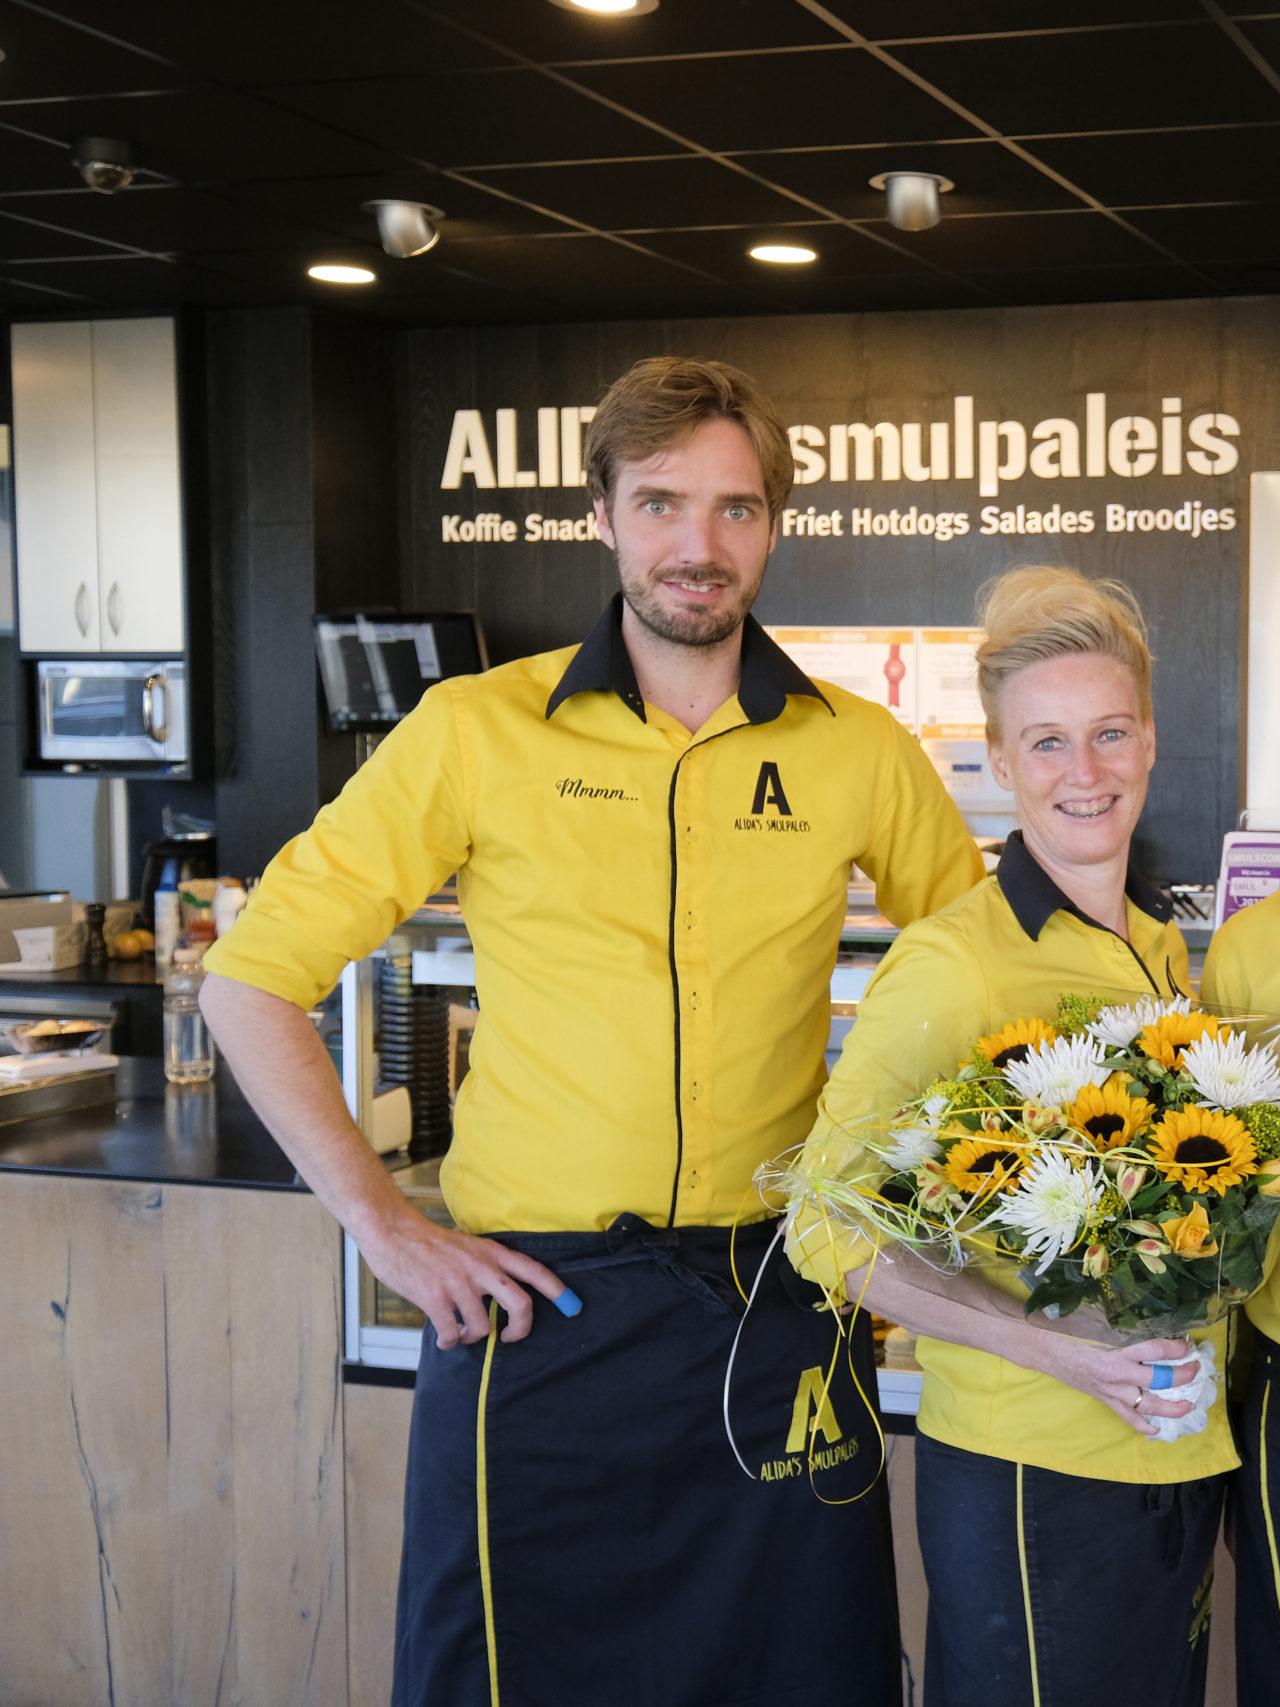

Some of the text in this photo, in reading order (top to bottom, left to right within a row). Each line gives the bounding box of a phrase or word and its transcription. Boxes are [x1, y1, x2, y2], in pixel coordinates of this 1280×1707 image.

[788, 393, 1240, 497] smulpaleis
[442, 501, 1236, 543] Koffie Snack Friet Hotdogs Salades Broodjes
[751, 761, 792, 816] A
[734, 818, 811, 832] ALIDA'S SMULPALEIS
[785, 1366, 843, 1453] A
[760, 1458, 802, 1482] ALIDA'S
